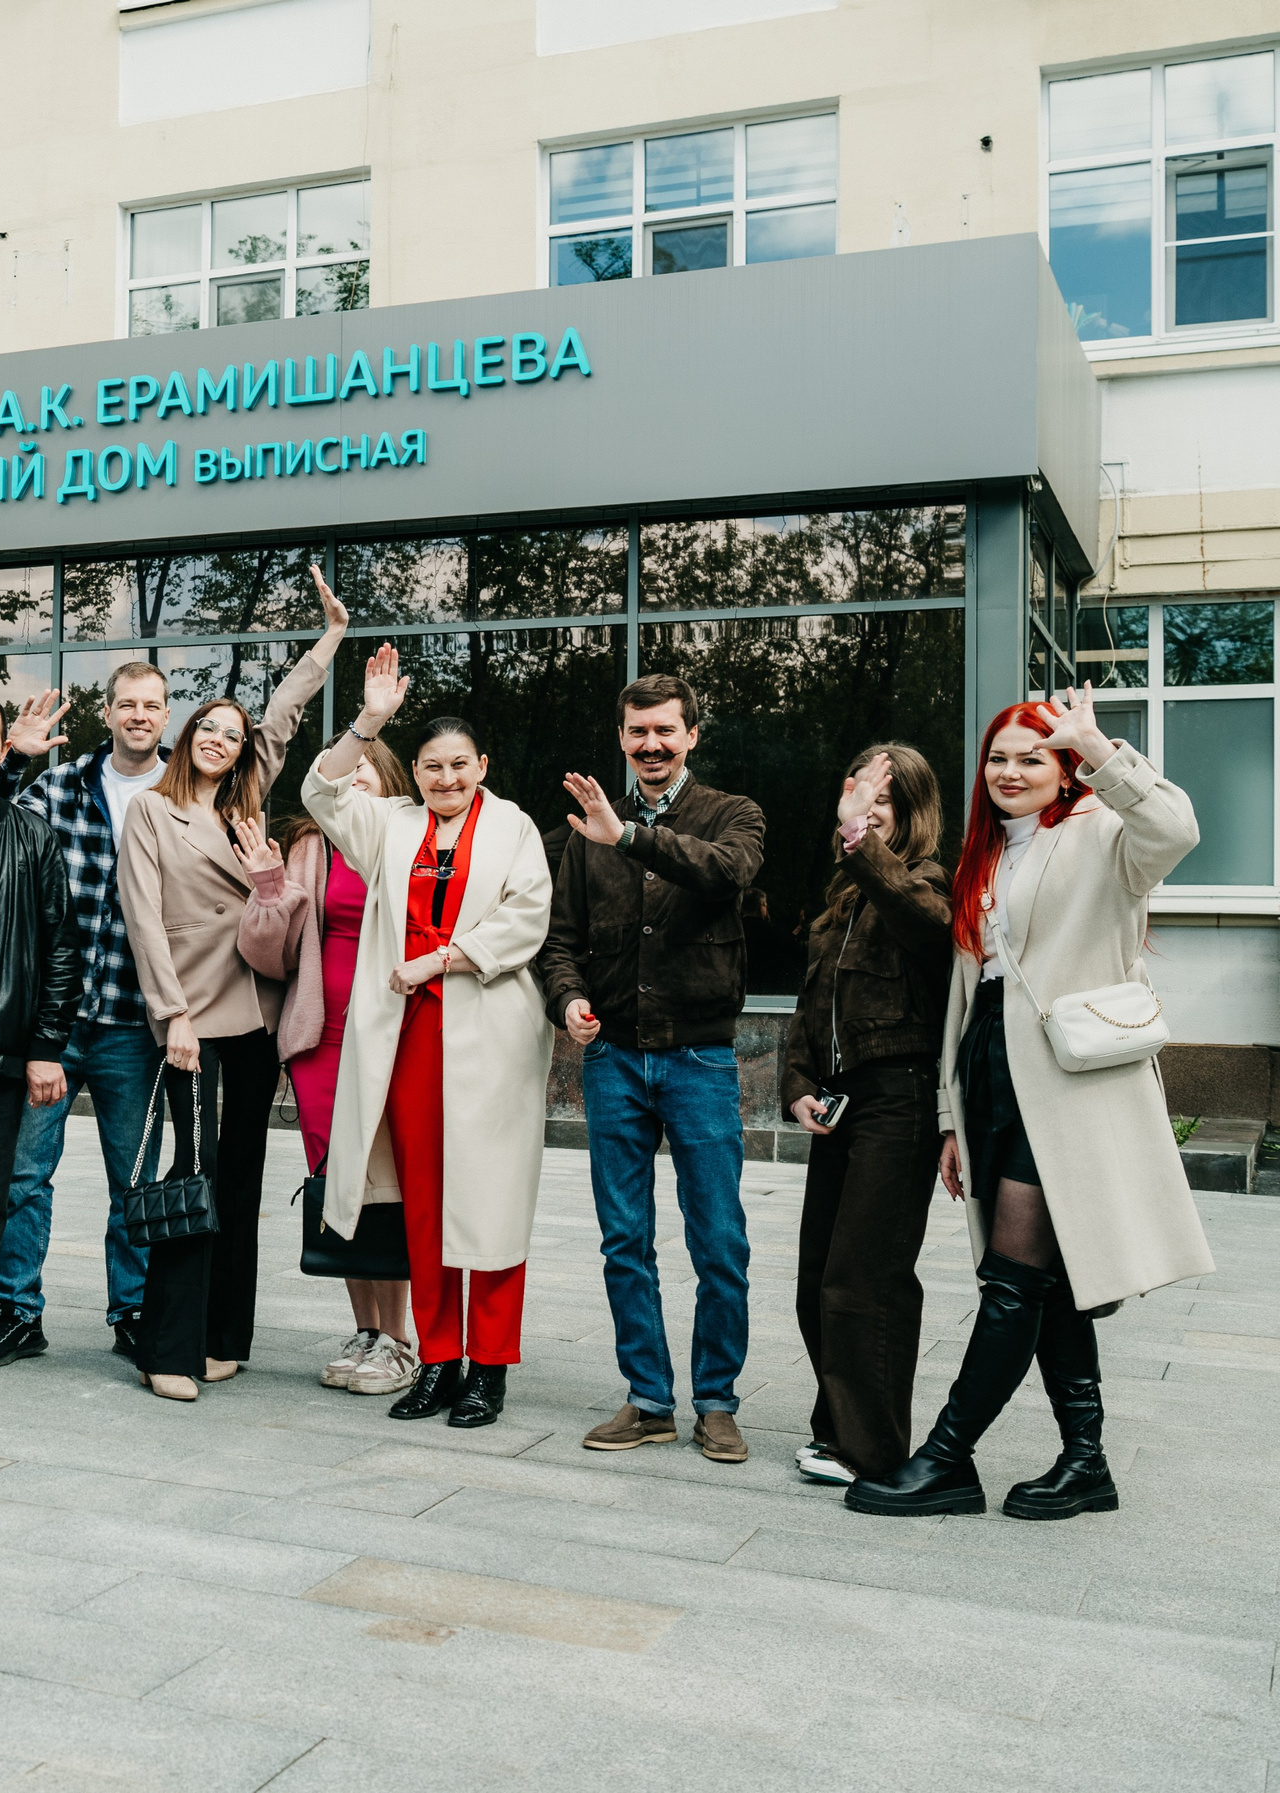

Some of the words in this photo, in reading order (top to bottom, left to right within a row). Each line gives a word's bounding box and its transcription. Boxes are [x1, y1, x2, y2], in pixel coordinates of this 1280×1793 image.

[96, 327, 592, 426] ЕРАМИШАНЦЕВА
[56, 439, 177, 506] ДОМ
[194, 428, 426, 484] ВЫПИСНАЯ
